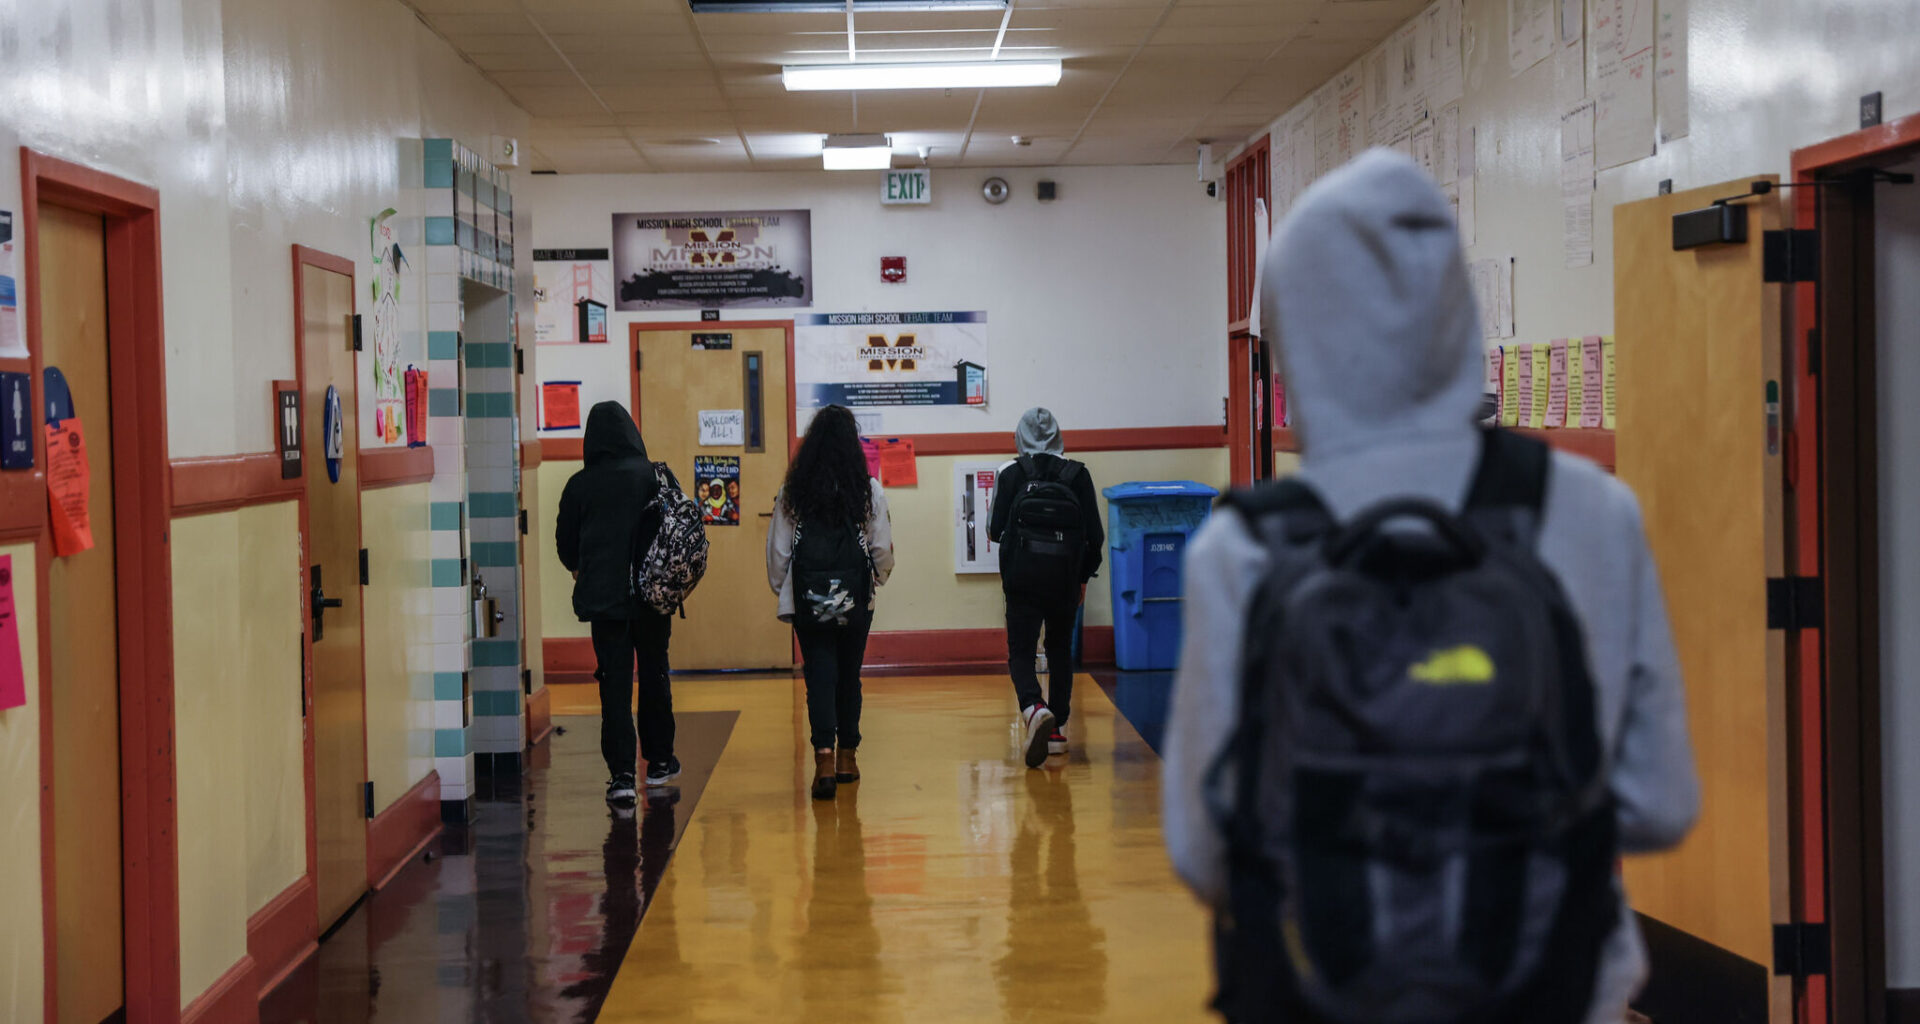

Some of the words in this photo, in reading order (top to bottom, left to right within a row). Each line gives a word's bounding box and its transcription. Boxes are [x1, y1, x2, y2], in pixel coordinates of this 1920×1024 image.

[887, 172, 923, 199] EXIT
[637, 218, 670, 229] MISSION
[671, 218, 691, 228] HIGH
[692, 217, 724, 228] SCHOOL
[684, 241, 741, 250] MISSION
[828, 314, 857, 324] MISSION
[858, 314, 874, 323] HIGH
[875, 313, 901, 323] SCHOOL
[903, 312, 929, 323] DEBATE
[933, 312, 953, 322] TEAM
[860, 347, 923, 355] MISSION
[701, 415, 741, 428] WELCOME
[710, 425, 734, 438] ALL!
[12, 440, 26, 452] GIRLS
